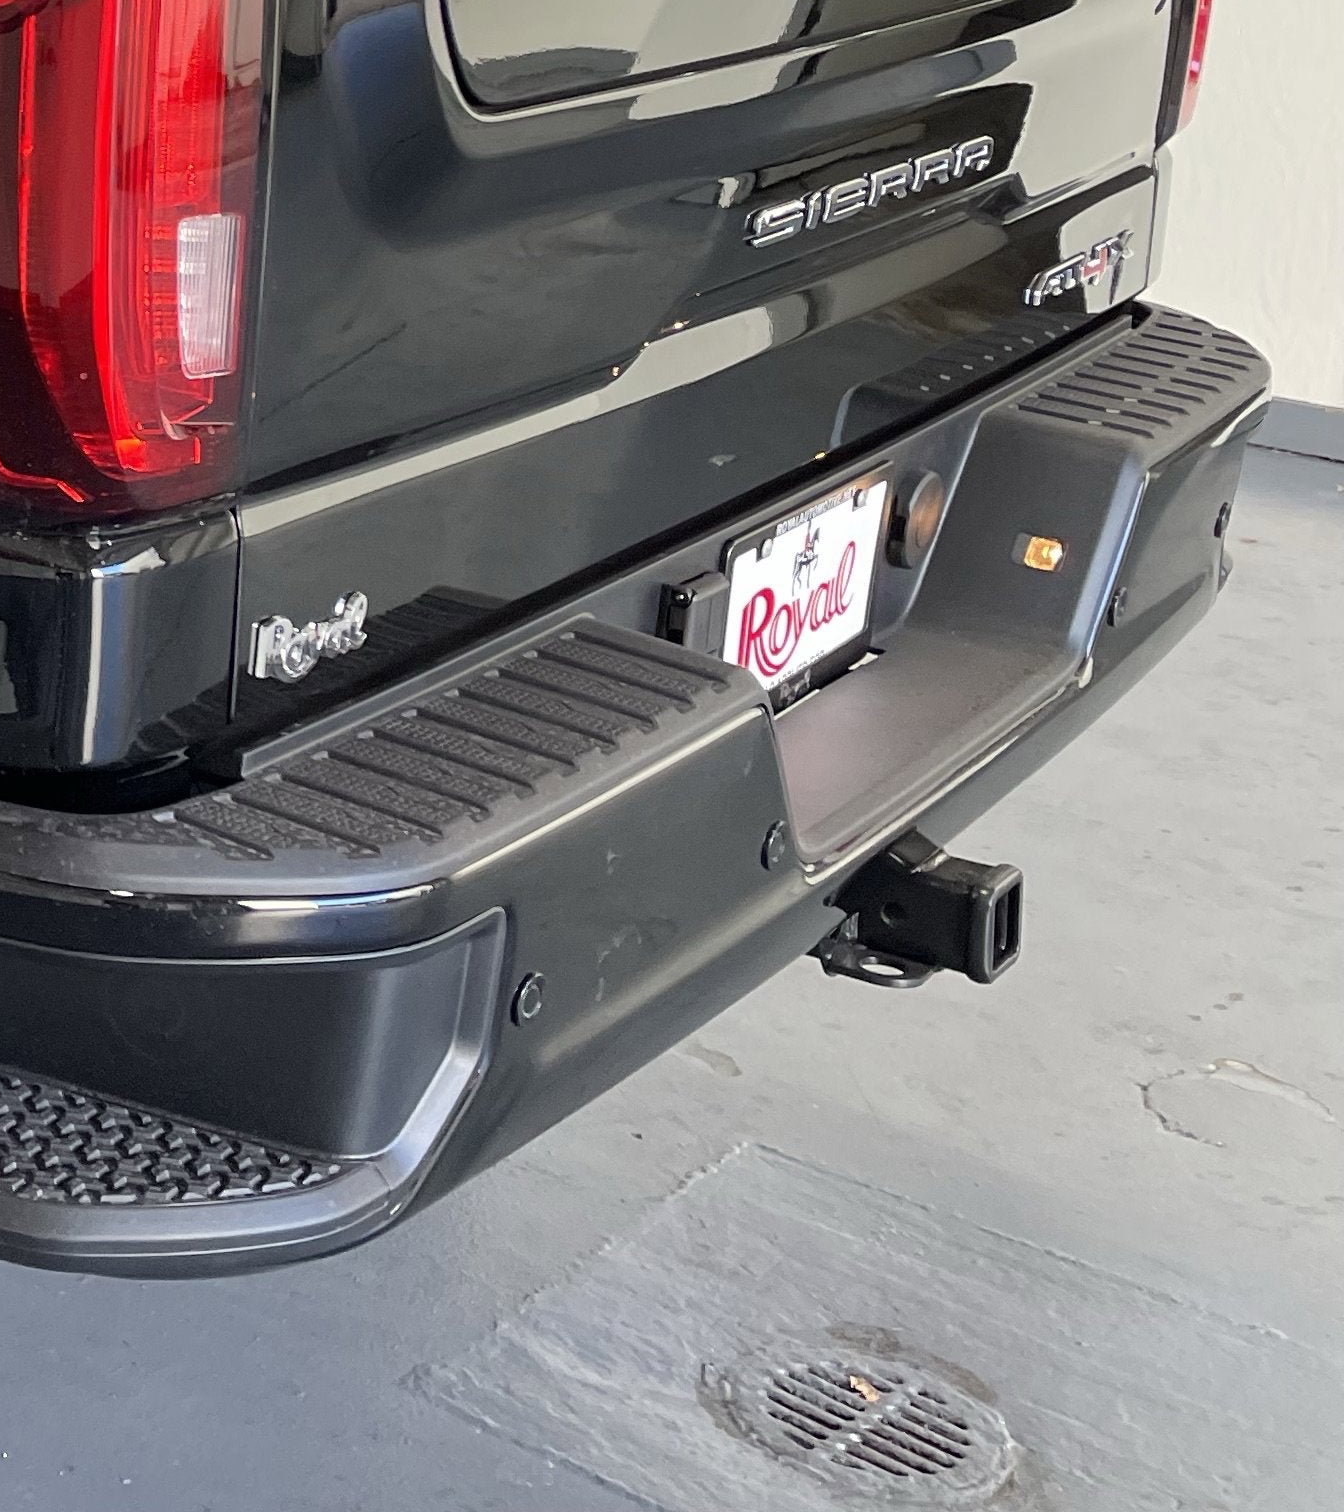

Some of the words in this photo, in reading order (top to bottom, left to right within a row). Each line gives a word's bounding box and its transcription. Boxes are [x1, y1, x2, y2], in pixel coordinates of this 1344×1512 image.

[744, 135, 995, 248] SIERRA
[1022, 228, 1135, 307] AT4X
[737, 541, 856, 677] Royal
